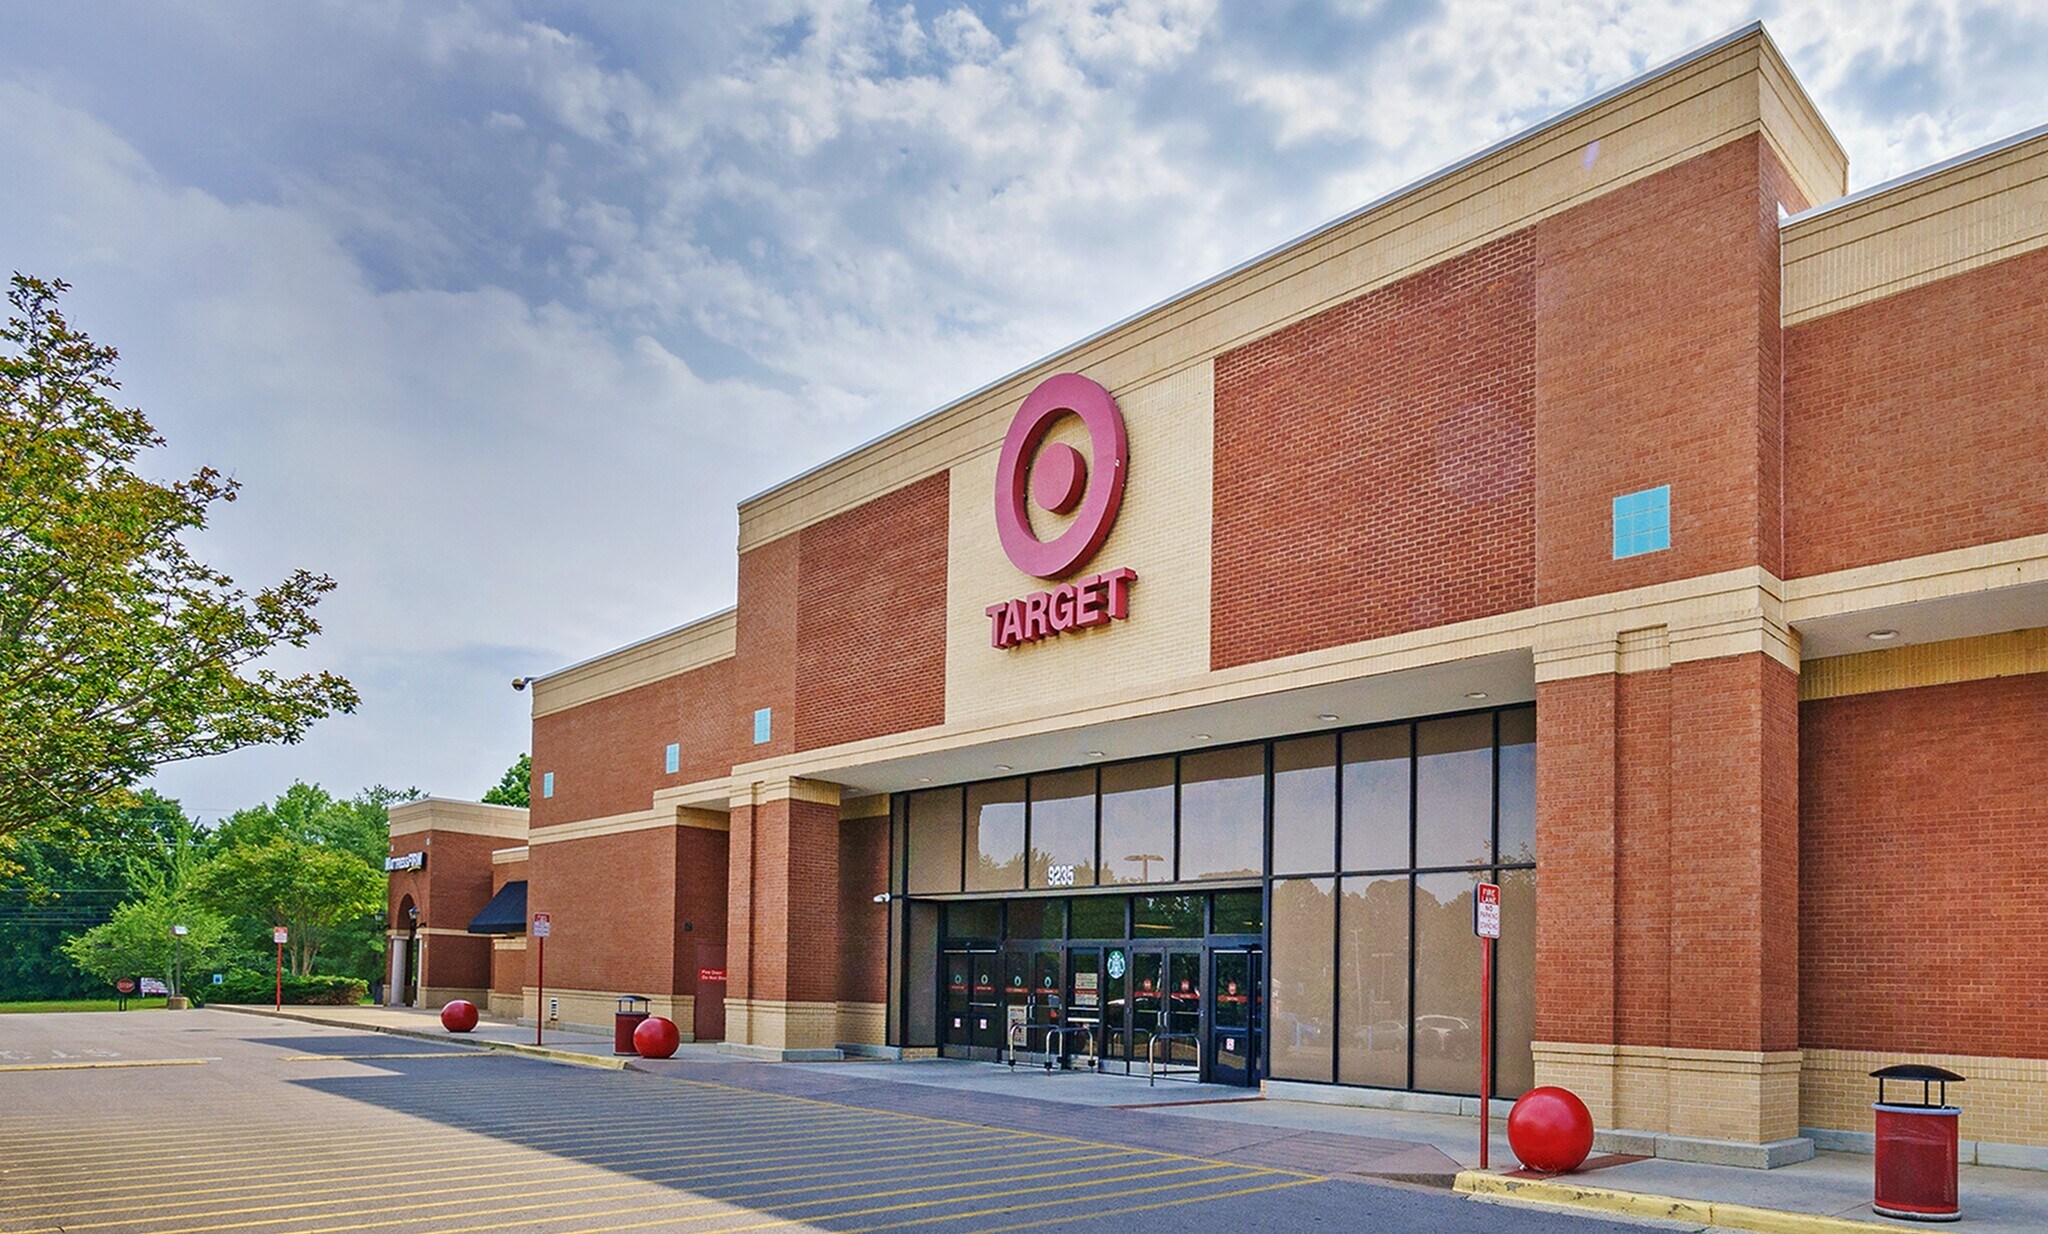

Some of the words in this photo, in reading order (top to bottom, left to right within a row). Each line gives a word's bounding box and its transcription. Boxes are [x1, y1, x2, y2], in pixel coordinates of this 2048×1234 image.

[985, 567, 1137, 649] TARGET
[1048, 865, 1074, 885] 9235
[1481, 895, 1497, 904] LANE
[1482, 888, 1496, 897] FIRE
